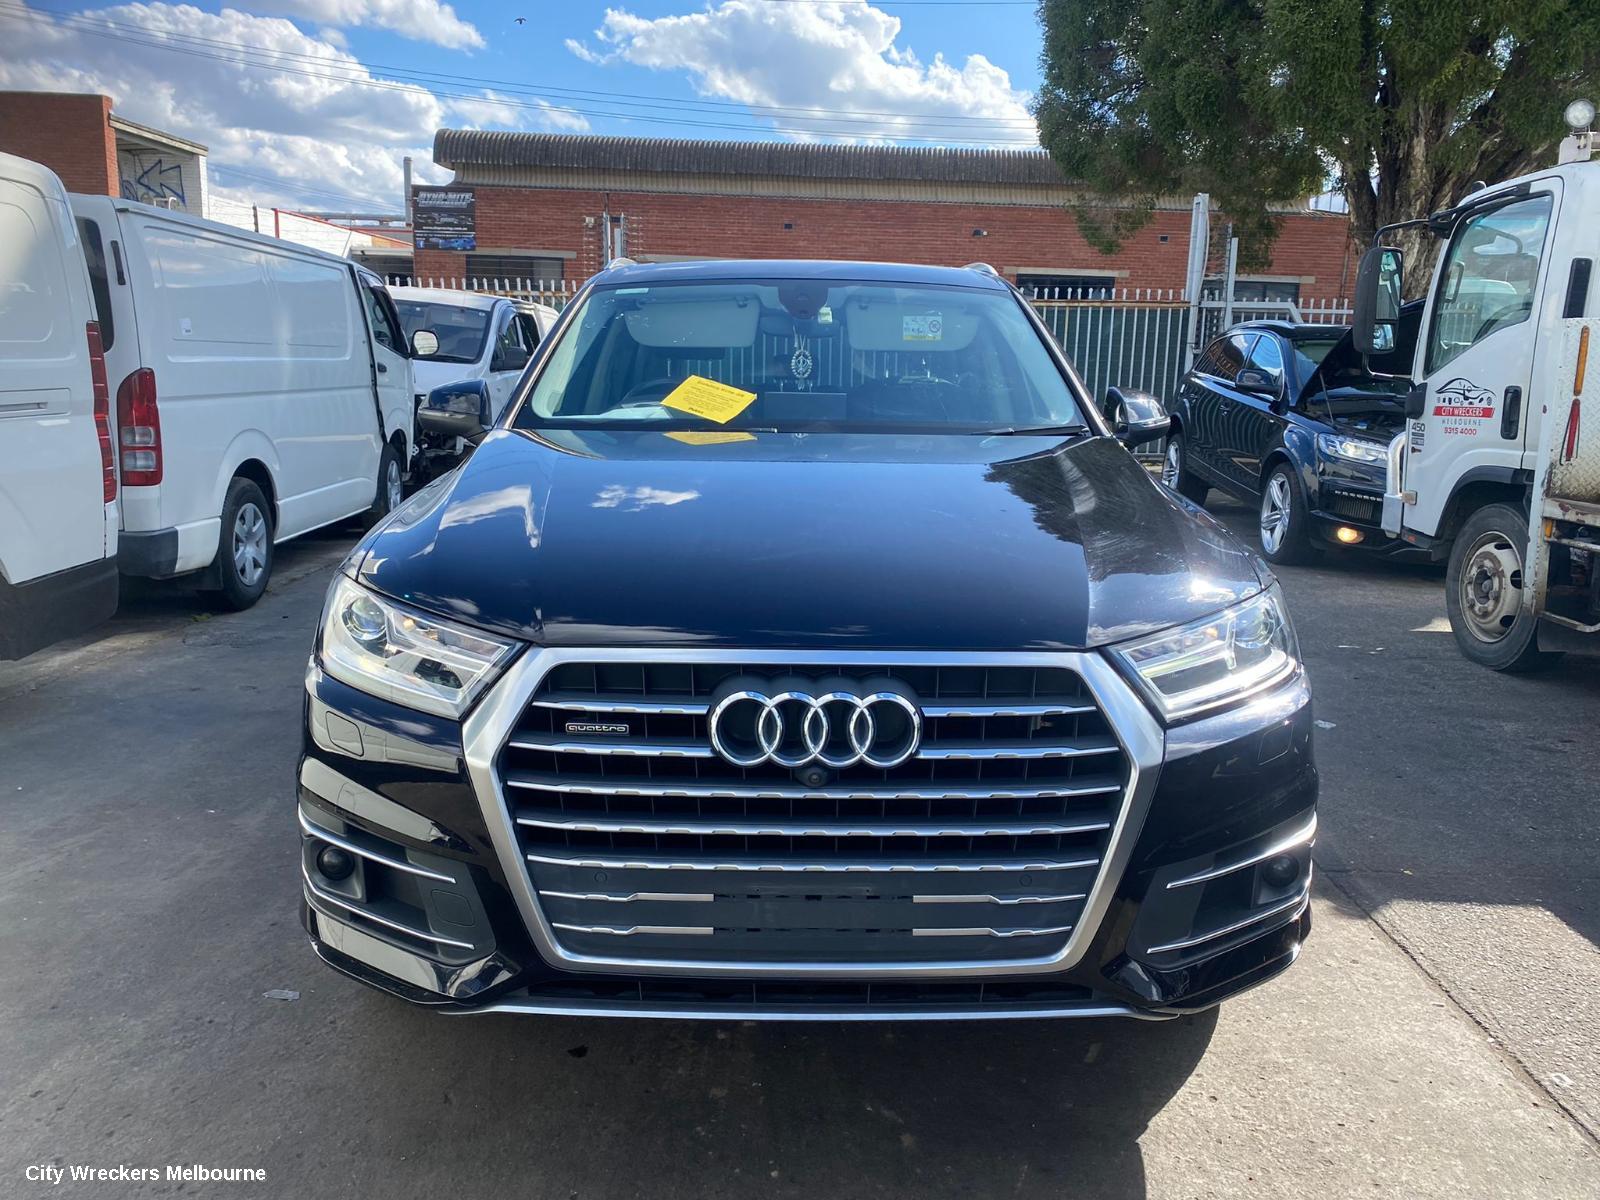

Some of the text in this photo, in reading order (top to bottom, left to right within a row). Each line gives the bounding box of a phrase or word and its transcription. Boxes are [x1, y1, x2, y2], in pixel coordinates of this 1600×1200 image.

[1441, 407, 1484, 417] CITY WRECKERS
[1411, 422, 1426, 433] 450
[1441, 419, 1481, 427] MELBOURNE
[1459, 428, 1478, 436] 4000
